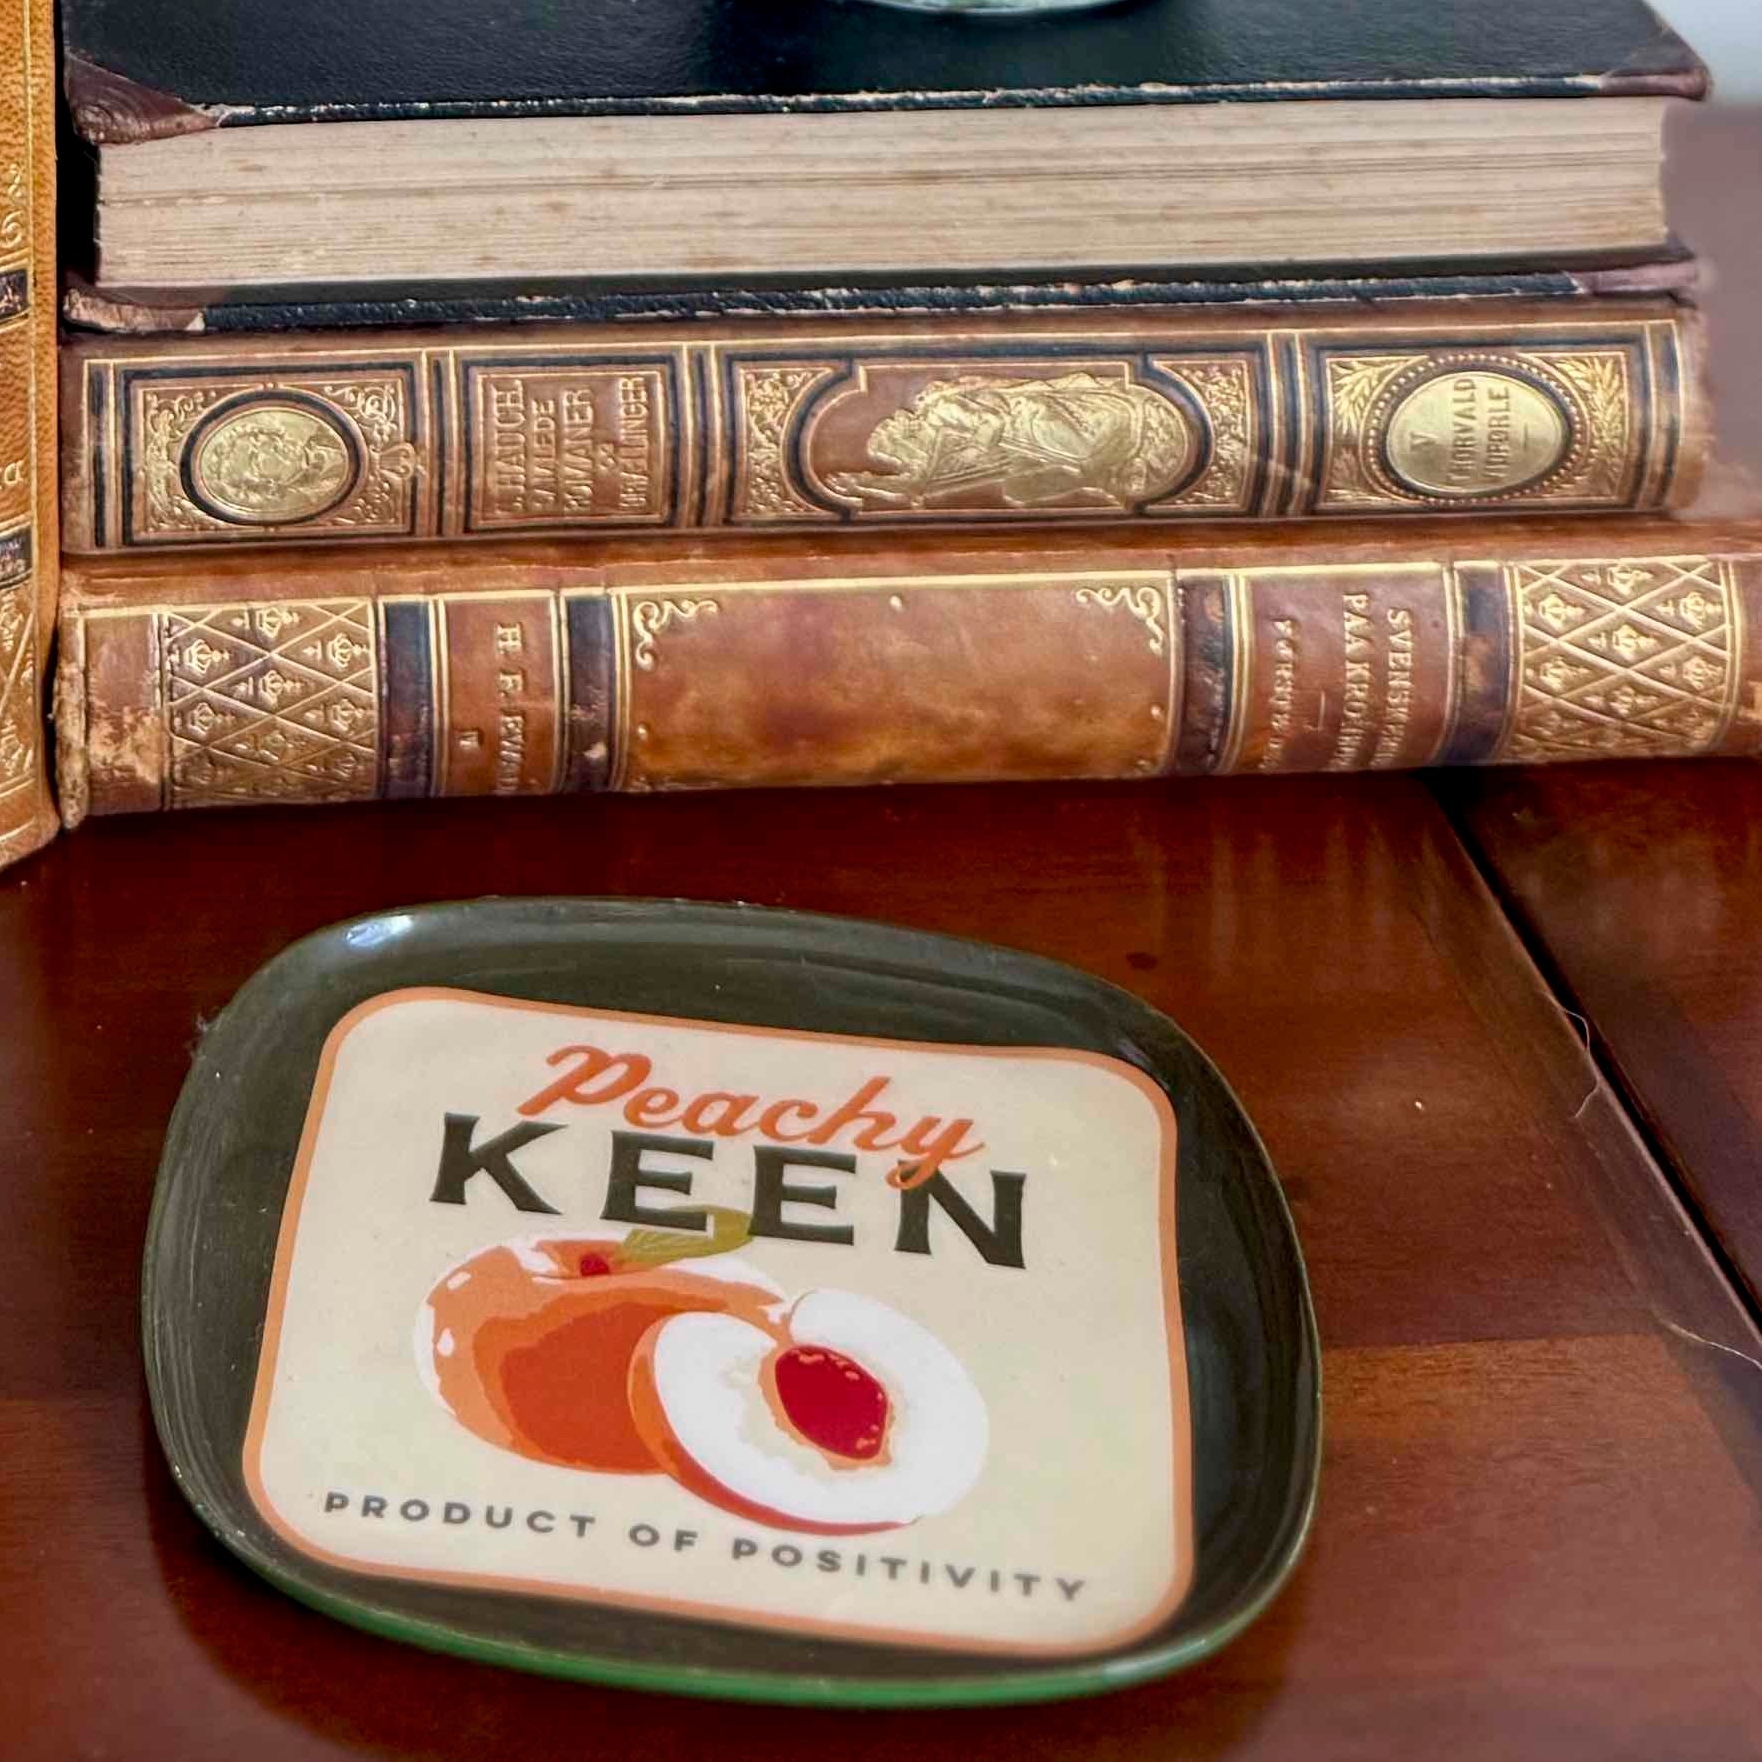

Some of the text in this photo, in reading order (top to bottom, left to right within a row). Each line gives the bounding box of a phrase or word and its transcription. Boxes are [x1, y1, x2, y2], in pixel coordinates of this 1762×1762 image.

[1342, 594, 1374, 654] PAA
[517, 1044, 986, 1190] Peachy
[429, 1112, 1028, 1270] KEEN
[324, 1491, 1085, 1602] PRODUCT OF POSITIVITY
